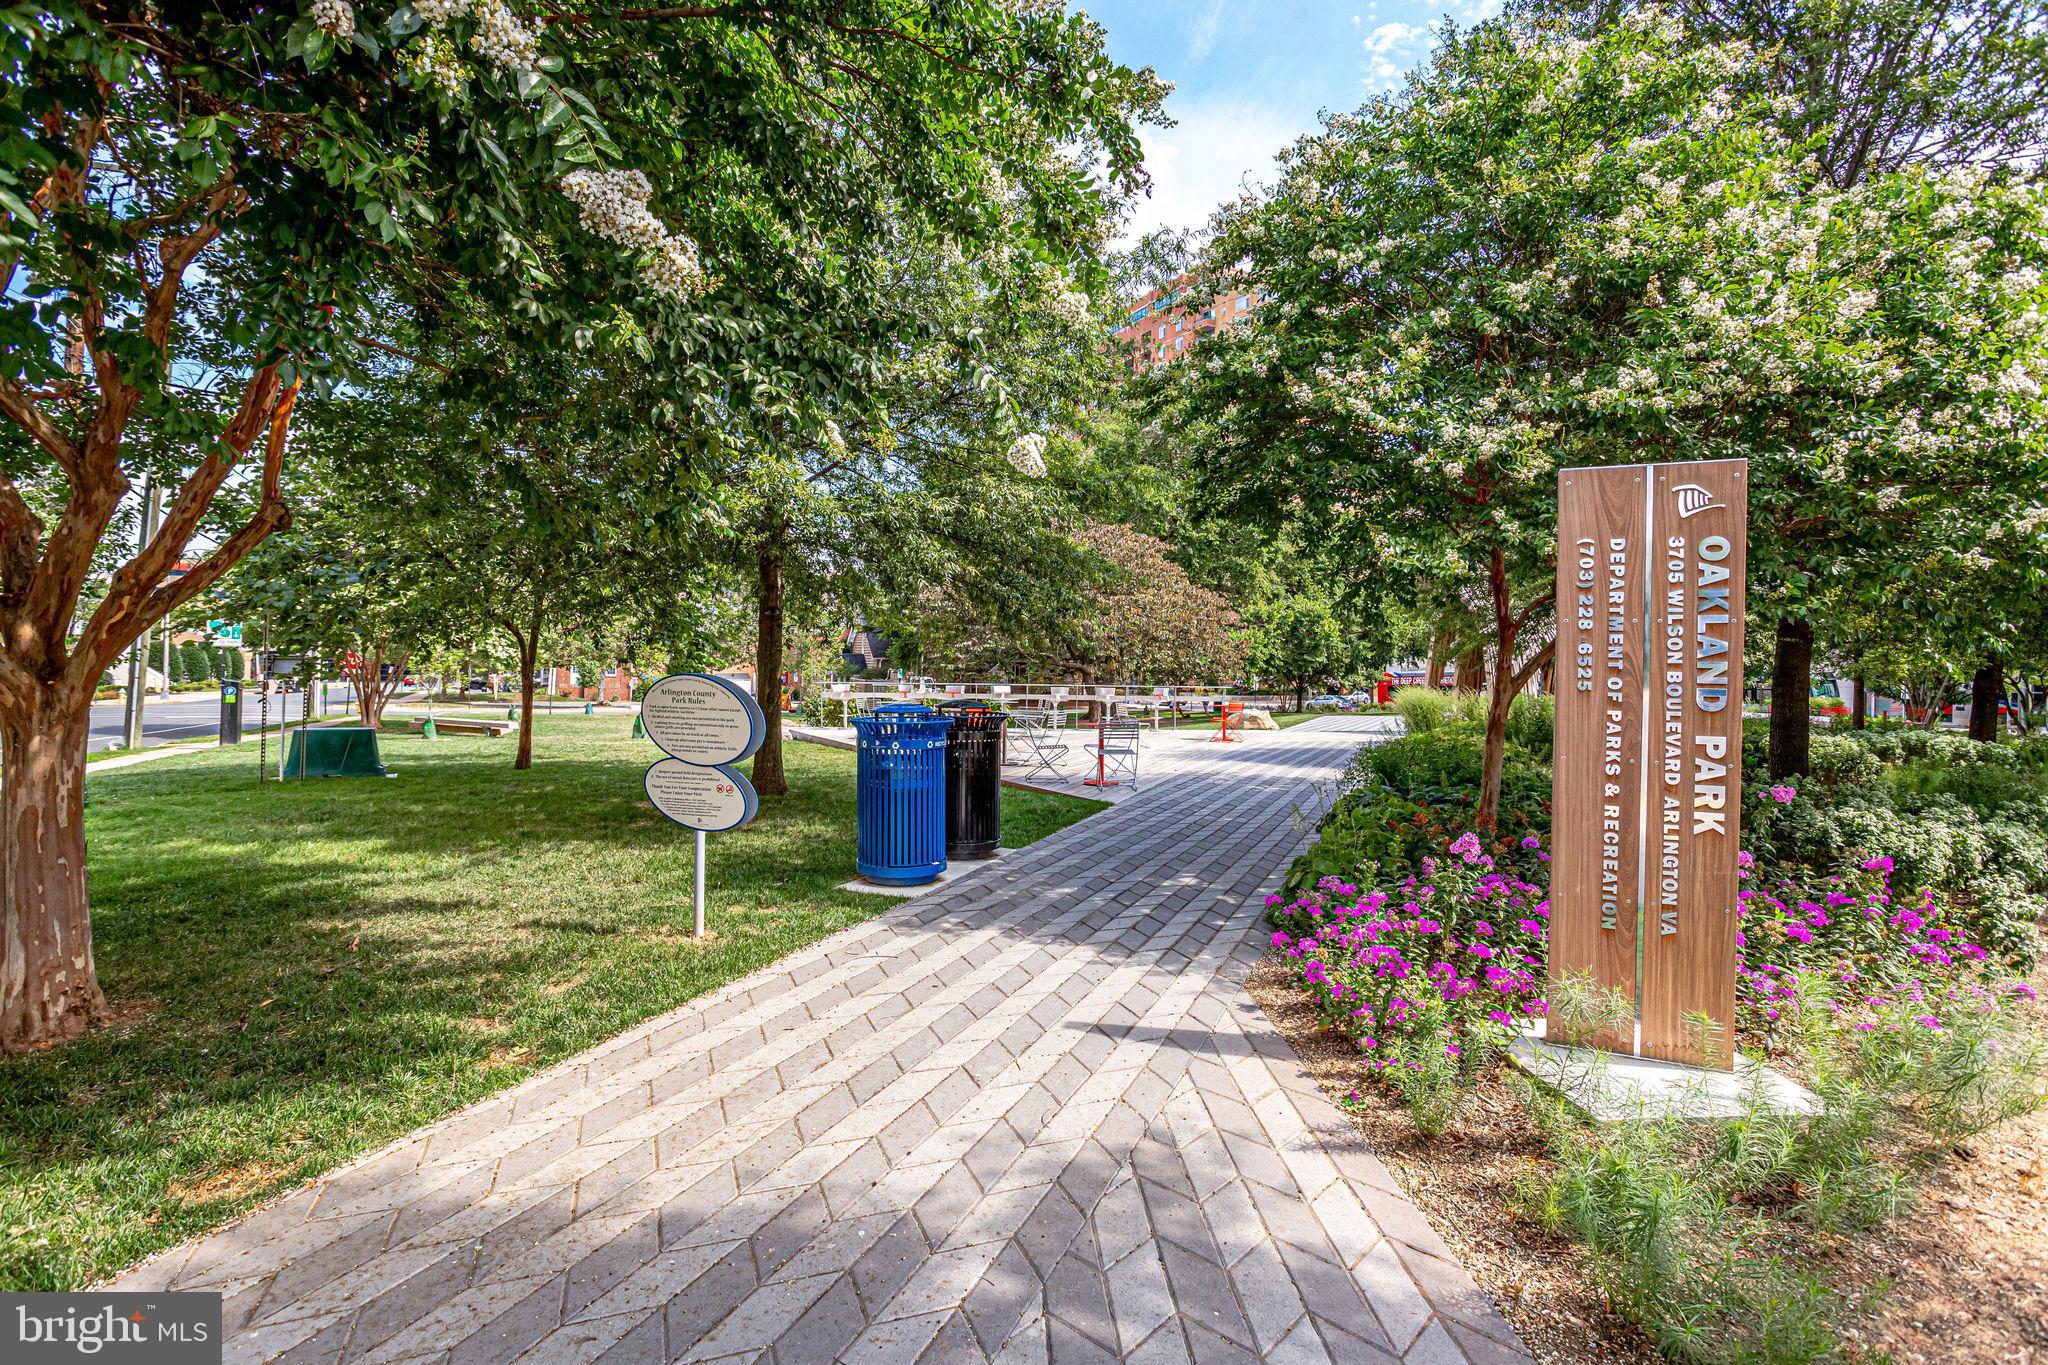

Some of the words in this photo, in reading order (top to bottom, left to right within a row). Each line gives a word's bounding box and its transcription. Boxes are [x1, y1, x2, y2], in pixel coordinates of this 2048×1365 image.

[1576, 538, 1595, 588] (703)
[1667, 536, 1685, 584] 3705
[1607, 538, 1626, 670] DEPARTMENT
[1666, 589, 1684, 664] WILSON
[1696, 535, 1730, 712] OAKLAND
[660, 688, 692, 698] Arlington
[692, 690, 716, 698] County
[1606, 677, 1624, 702] OF
[1605, 710, 1622, 776] PARKS
[1664, 671, 1683, 786] BOULEVARD
[1604, 783, 1620, 797] &
[1693, 736, 1727, 836] PARK
[1600, 804, 1620, 930] RECREATION
[1661, 796, 1680, 906] ARLINGTON
[1660, 912, 1678, 936] VA
